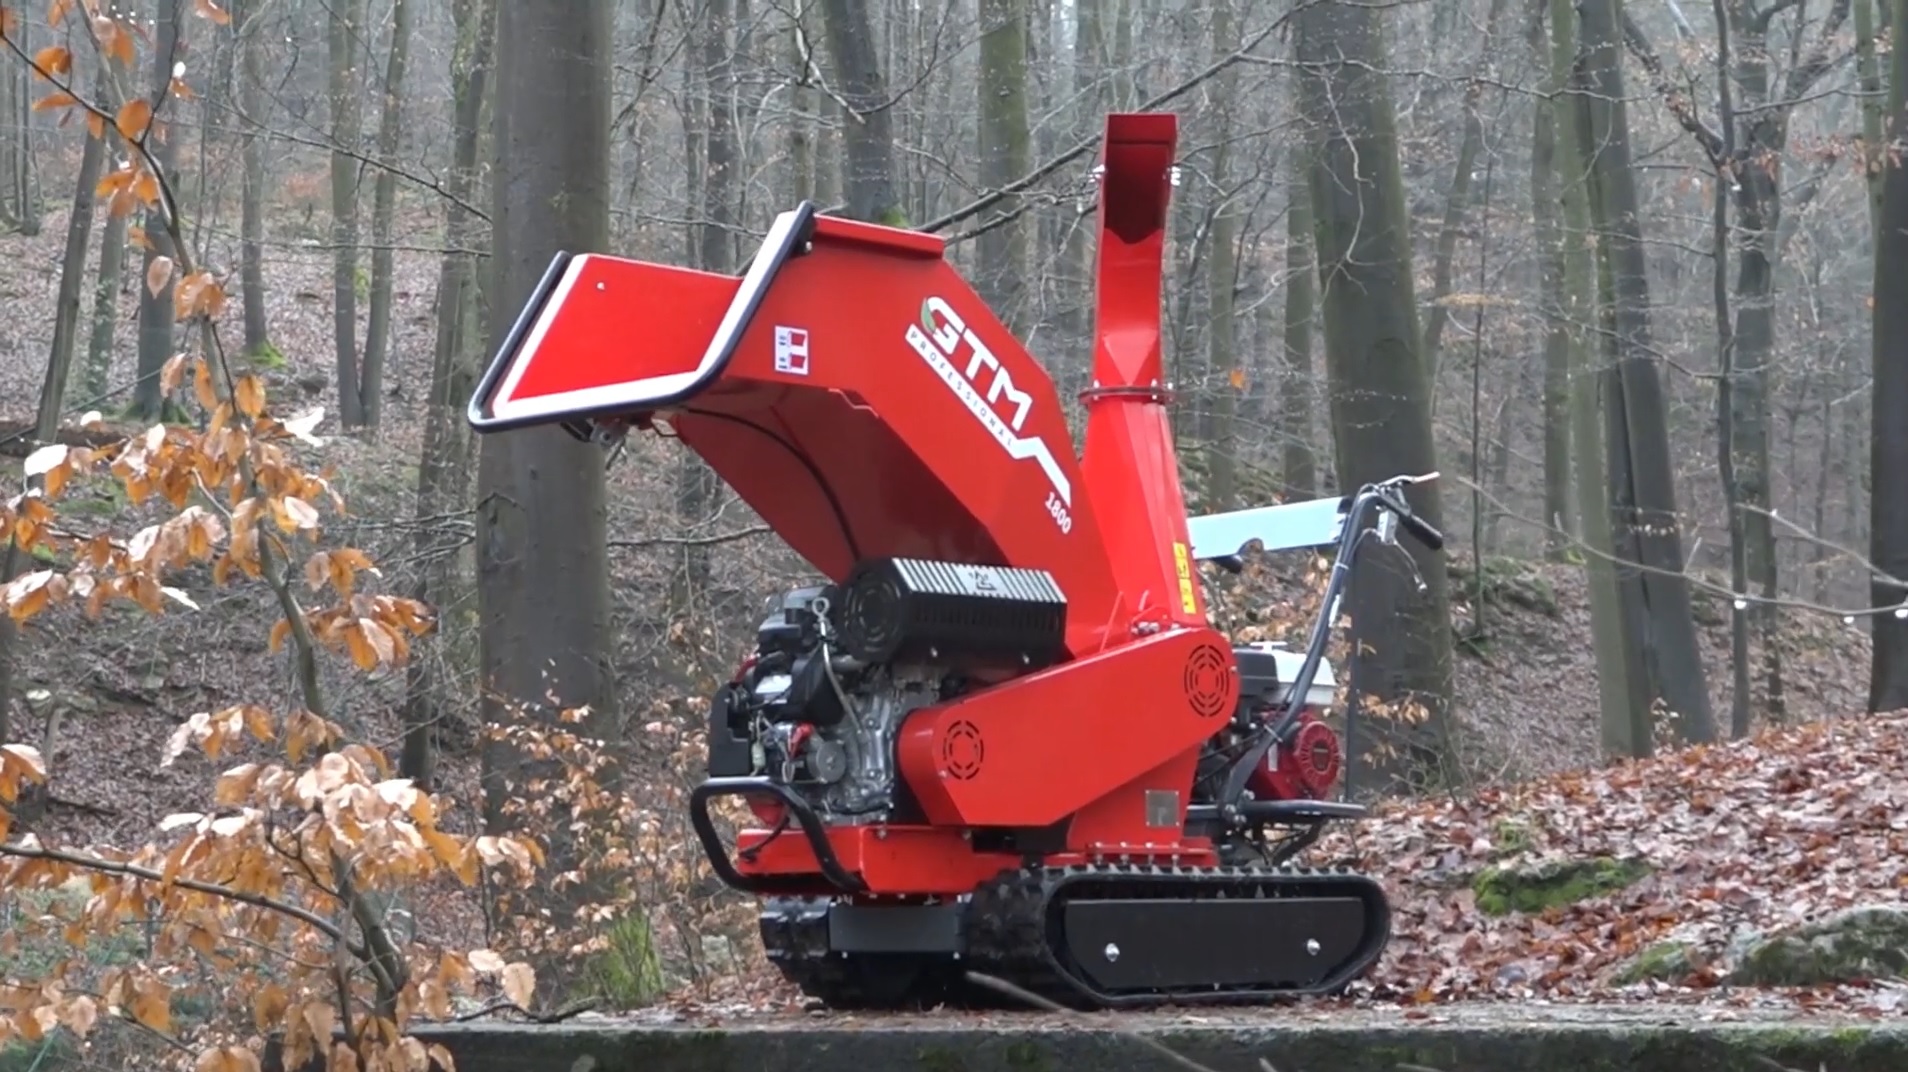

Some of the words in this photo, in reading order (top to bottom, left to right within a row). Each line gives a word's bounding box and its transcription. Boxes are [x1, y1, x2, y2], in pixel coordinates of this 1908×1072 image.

[909, 328, 1013, 448] PROFESSIONAL
[921, 296, 1033, 432] GTM
[1045, 491, 1072, 534] 1800
